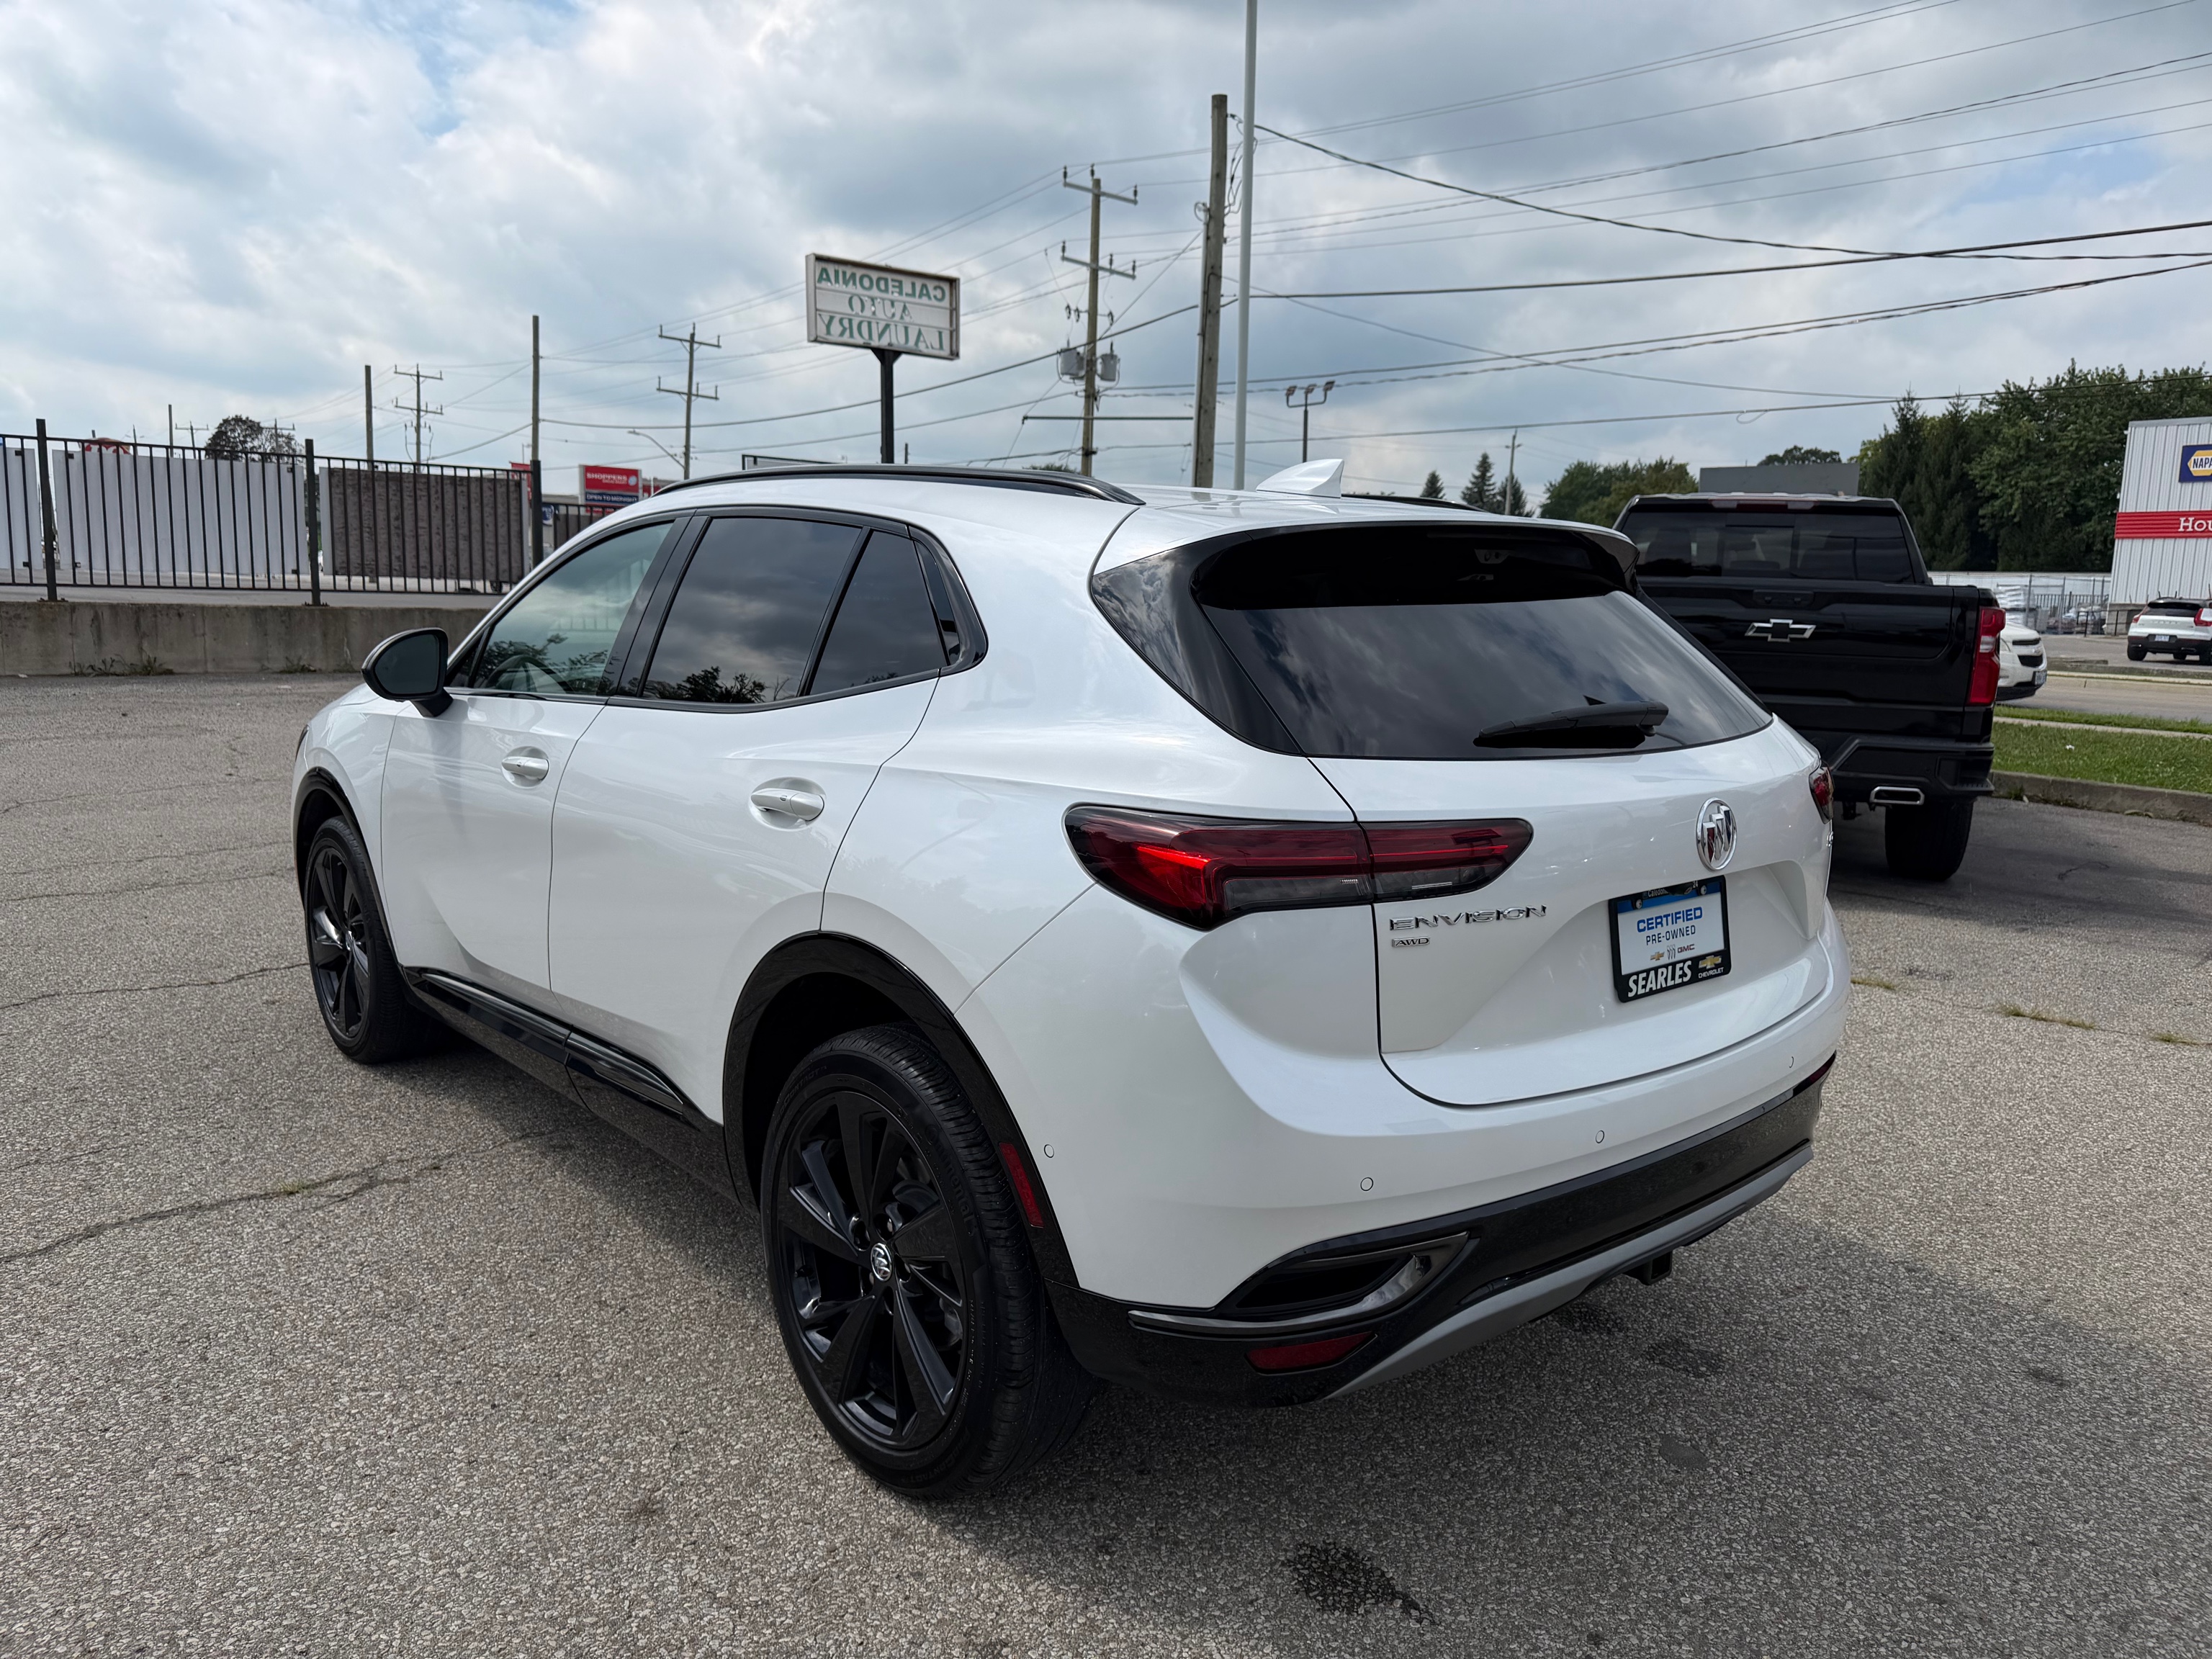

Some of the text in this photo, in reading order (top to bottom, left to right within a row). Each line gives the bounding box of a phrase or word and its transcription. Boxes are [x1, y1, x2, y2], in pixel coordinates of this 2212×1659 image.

[1389, 904, 1547, 931] ENVISION
[1637, 907, 1703, 933] CERTIFIED
[1395, 937, 1430, 947] AWD
[1646, 925, 1696, 945] PRE-OWNED
[1677, 944, 1695, 953] GMC
[1627, 961, 1692, 998] SEARLES
[1698, 967, 1725, 979] CHEVROLET
